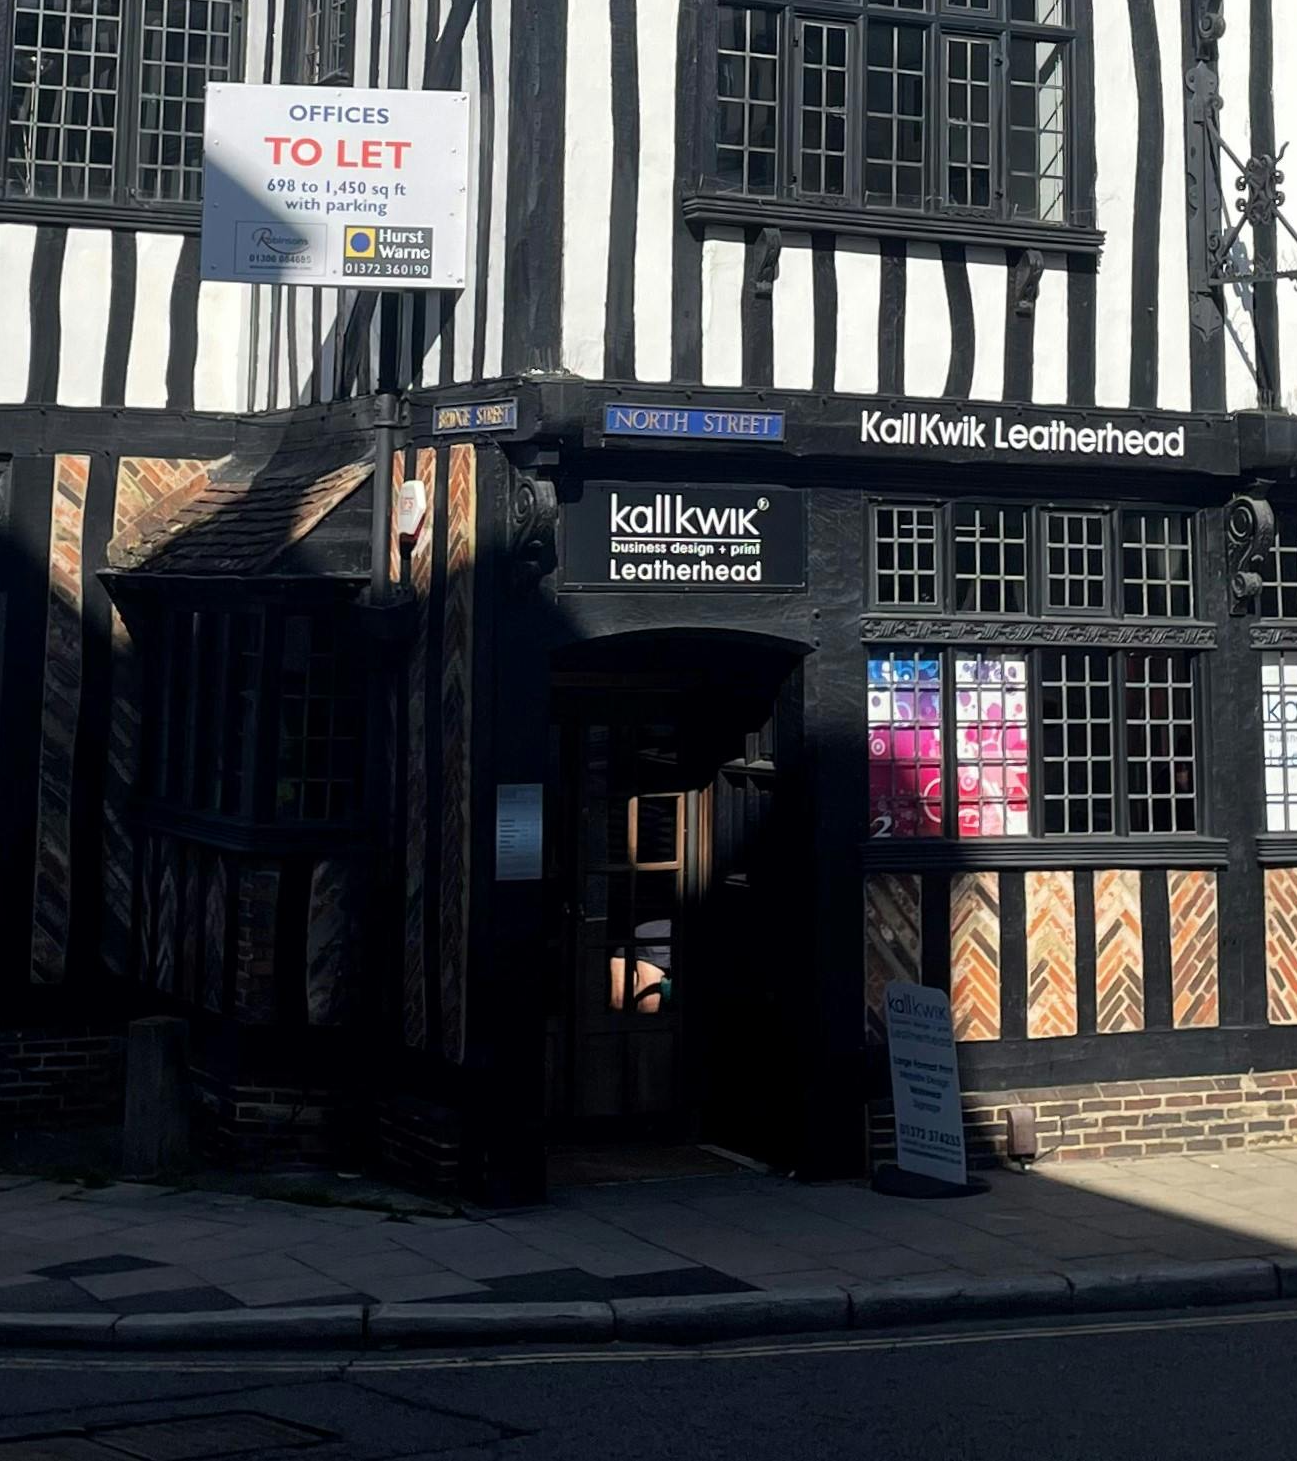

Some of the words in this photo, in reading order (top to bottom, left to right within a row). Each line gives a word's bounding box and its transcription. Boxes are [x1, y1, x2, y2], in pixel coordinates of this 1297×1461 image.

[289, 104, 390, 125] OFFICES
[264, 136, 323, 167] TO
[336, 139, 412, 170] LET
[266, 178, 296, 193] 698
[302, 180, 319, 194] to
[326, 180, 367, 196] 1,450
[371, 184, 389, 198] sq
[394, 181, 407, 196] ft
[285, 197, 321, 211] with
[325, 198, 388, 217] parking
[378, 228, 424, 244] Hurst
[378, 244, 431, 260] Warne
[345, 262, 381, 275] 01372
[385, 263, 429, 276] 360190
[614, 410, 689, 432] NORTH
[702, 413, 773, 435] STREET
[995, 417, 1185, 457] Leatherhead
[610, 541, 667, 554] business
[669, 541, 715, 557] design
[718, 545, 727, 554] +
[730, 542, 761, 557] print
[609, 558, 762, 582] Leatherhead
